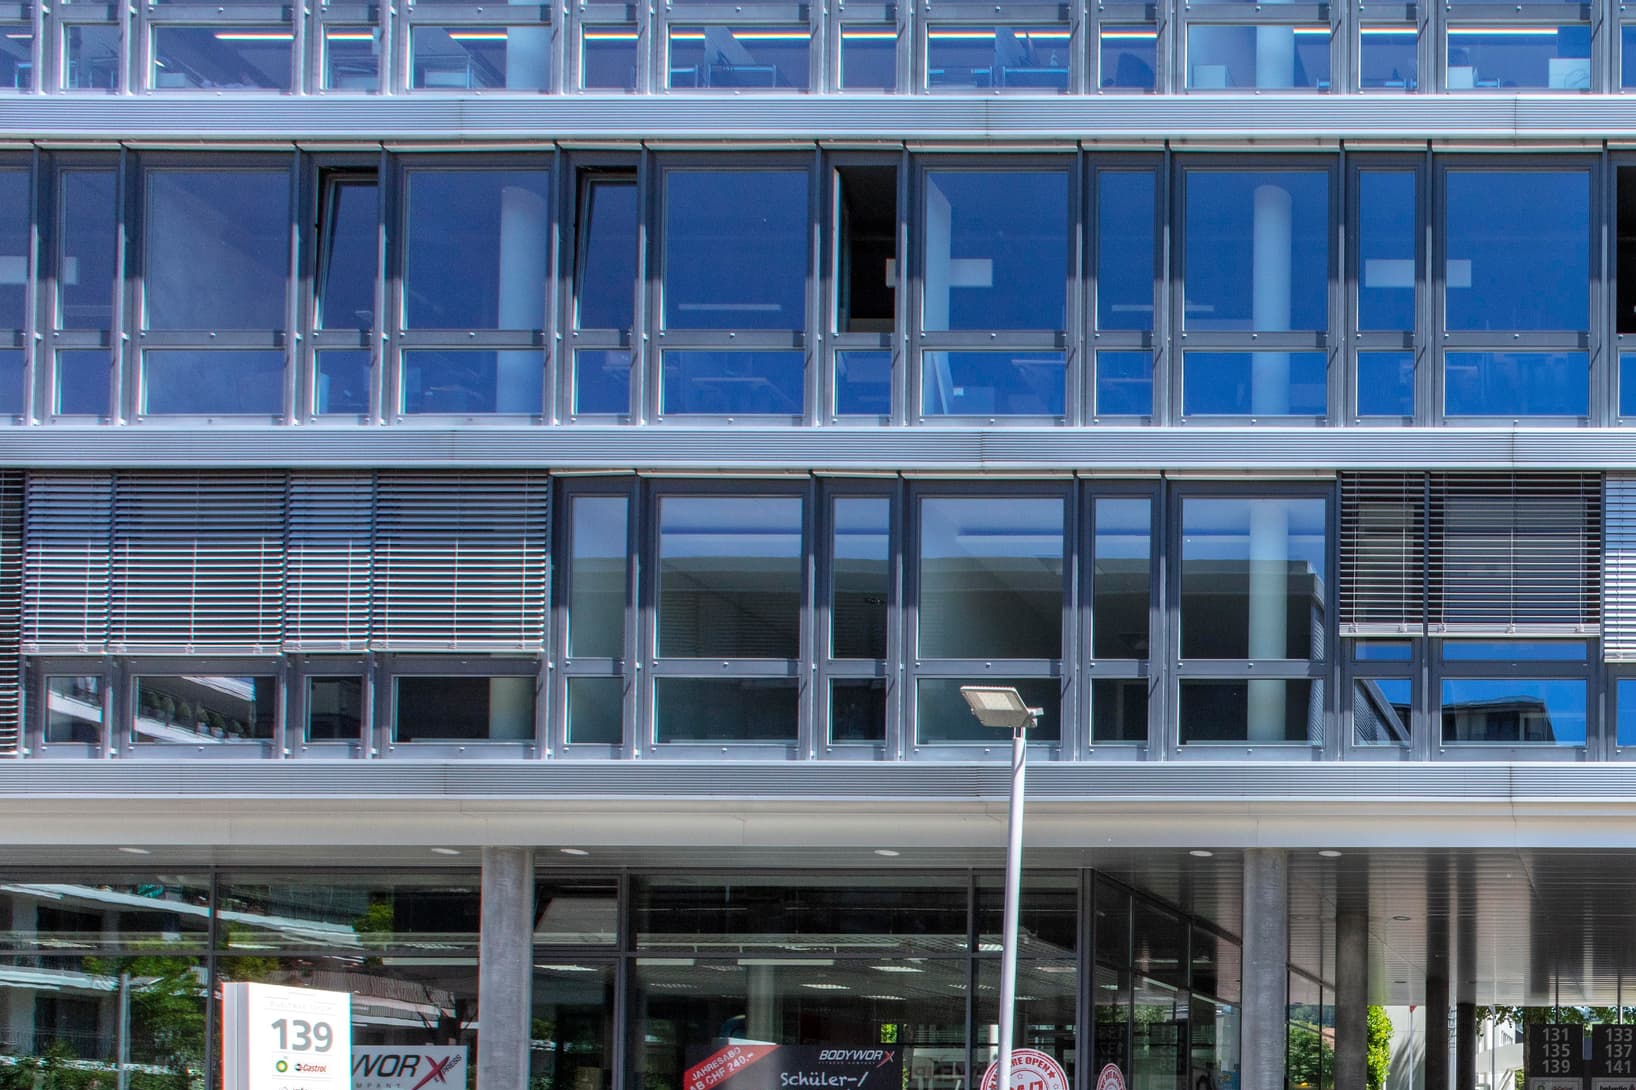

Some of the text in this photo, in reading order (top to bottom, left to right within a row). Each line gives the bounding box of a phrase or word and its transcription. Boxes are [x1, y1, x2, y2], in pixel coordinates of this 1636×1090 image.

[272, 1018, 333, 1052] 139
[1543, 1027, 1569, 1042] 131
[1606, 1028, 1633, 1042] 133
[1542, 1043, 1570, 1058] 135
[1605, 1044, 1632, 1058] 137
[302, 1063, 326, 1073] Castrol
[692, 1047, 741, 1081] JAHRESABO
[705, 1067, 725, 1084] CHF
[727, 1052, 754, 1072] 240.-
[1025, 1057, 1051, 1072] OPEN
[1542, 1060, 1571, 1073] 139
[1605, 1061, 1631, 1073] 141
[780, 1071, 869, 1087] Schüler-/
